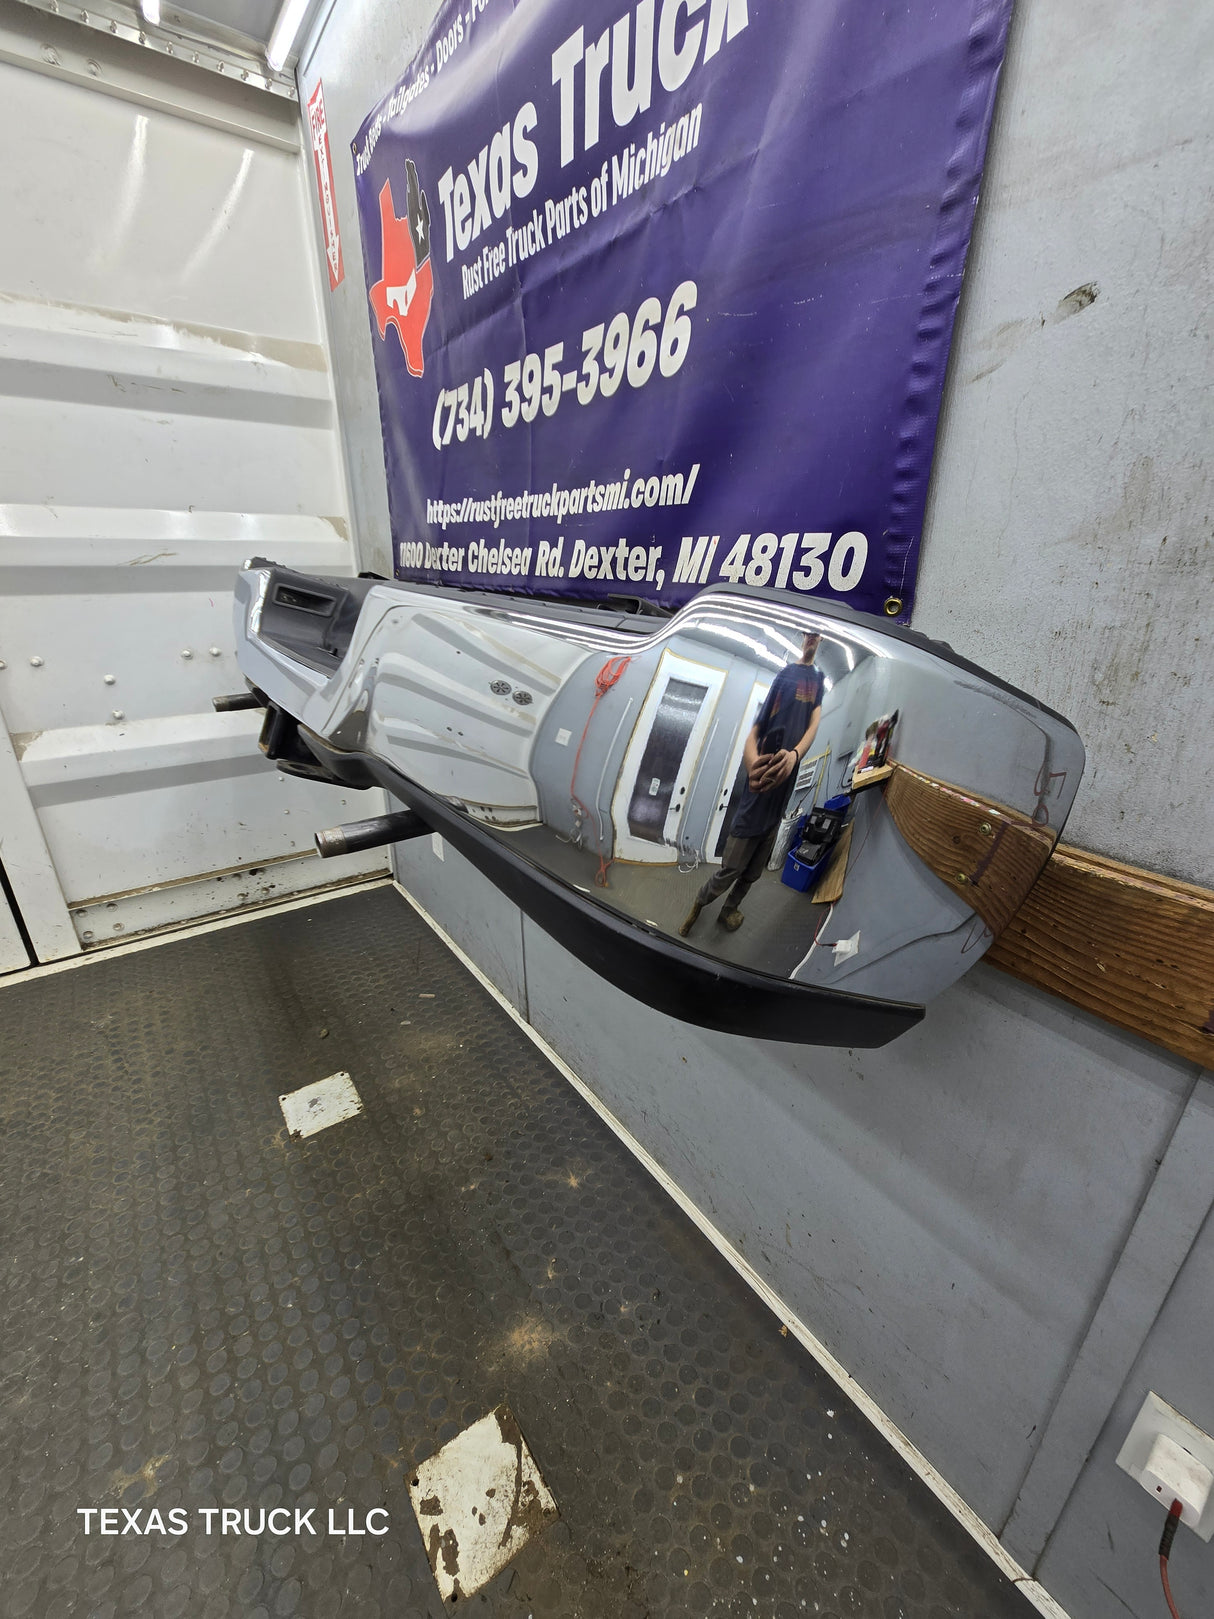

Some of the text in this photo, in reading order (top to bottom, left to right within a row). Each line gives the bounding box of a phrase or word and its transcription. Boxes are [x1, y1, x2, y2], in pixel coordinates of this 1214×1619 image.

[436, 13, 464, 73] Doors
[438, 102, 538, 263] Texas
[461, 102, 703, 300] Rust Free Truck Parts of Michigan
[431, 280, 698, 451] (734) 395-3966
[426, 463, 701, 530] https://rustfreetruckpartsmi.com/
[399, 531, 869, 592] 11600 Dexter Chelsea Rd. Dexter, MI 48130
